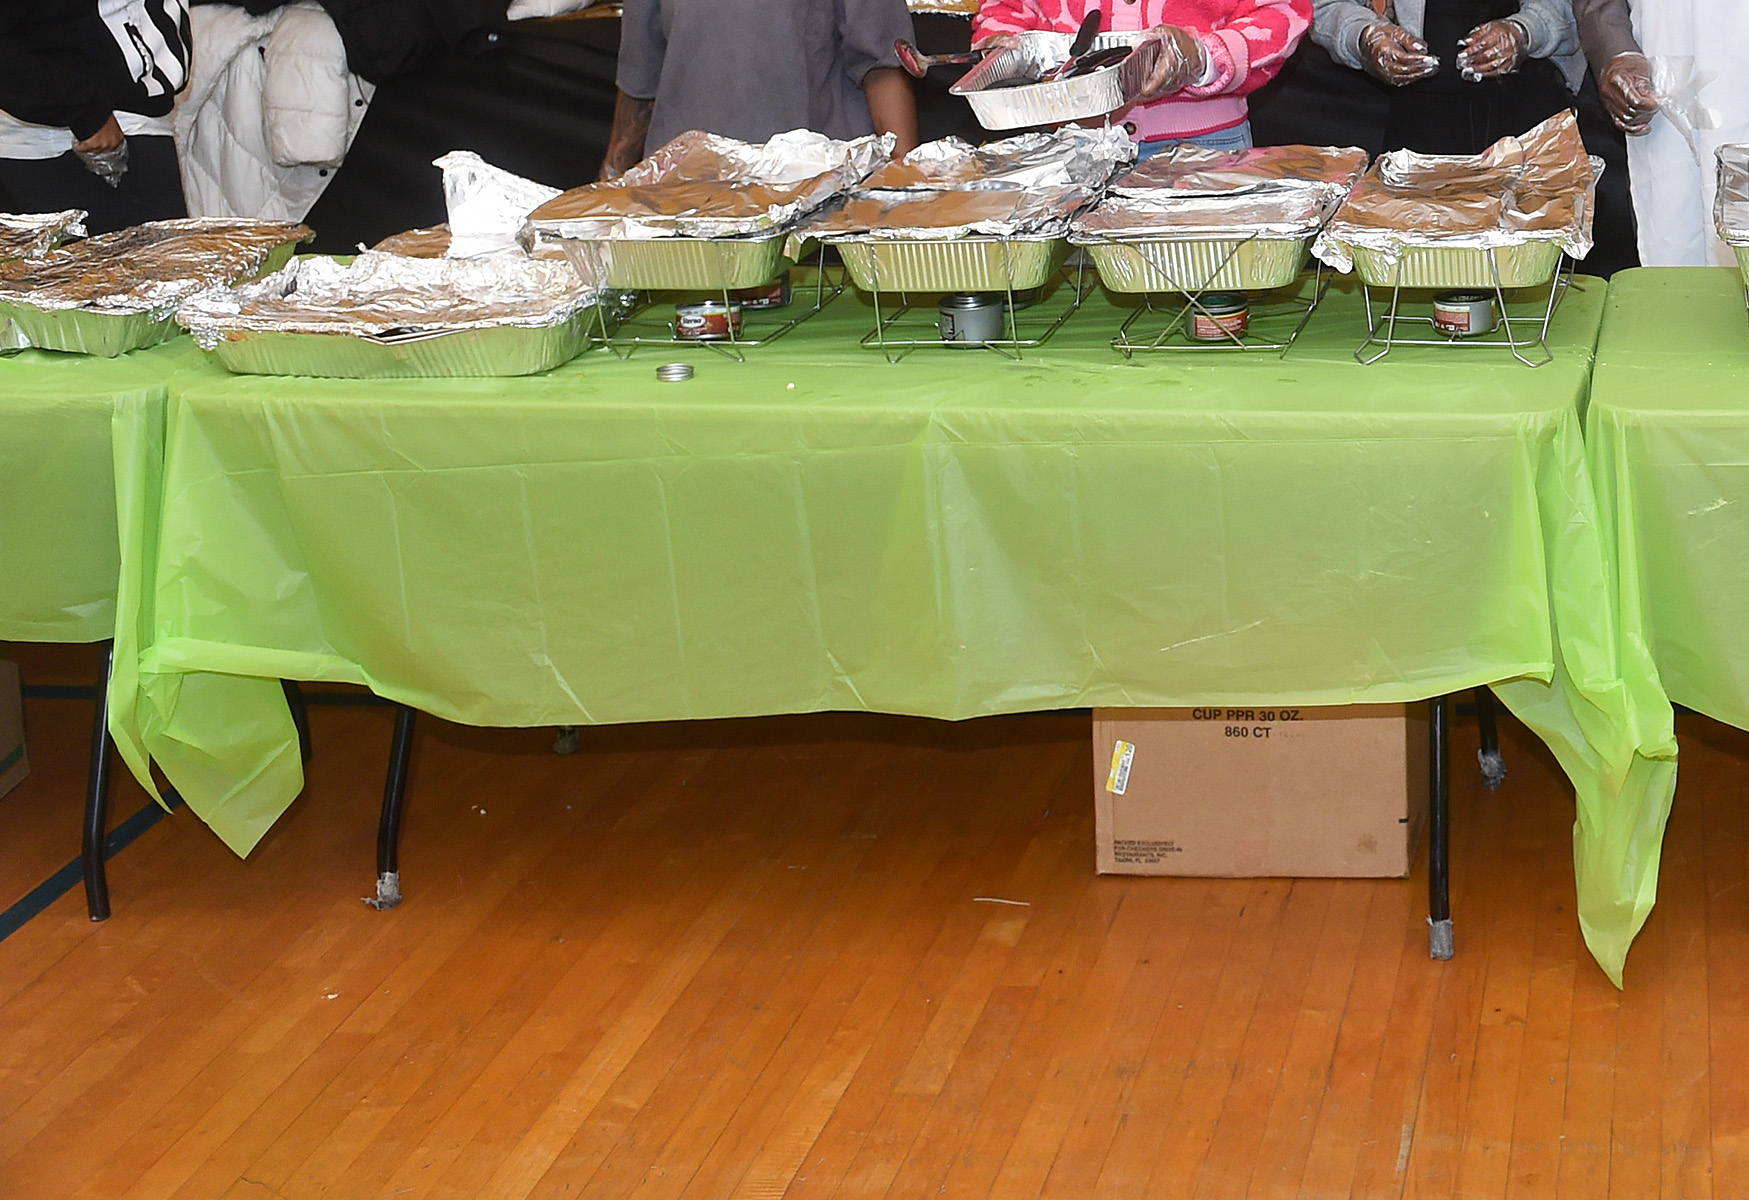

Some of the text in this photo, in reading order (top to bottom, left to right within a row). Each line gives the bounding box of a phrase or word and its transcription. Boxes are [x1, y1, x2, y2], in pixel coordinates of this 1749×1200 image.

[1192, 708, 1304, 721] CUP PPR 30 OZ.
[1224, 726, 1248, 738] 860
[1253, 726, 1271, 738] CT
